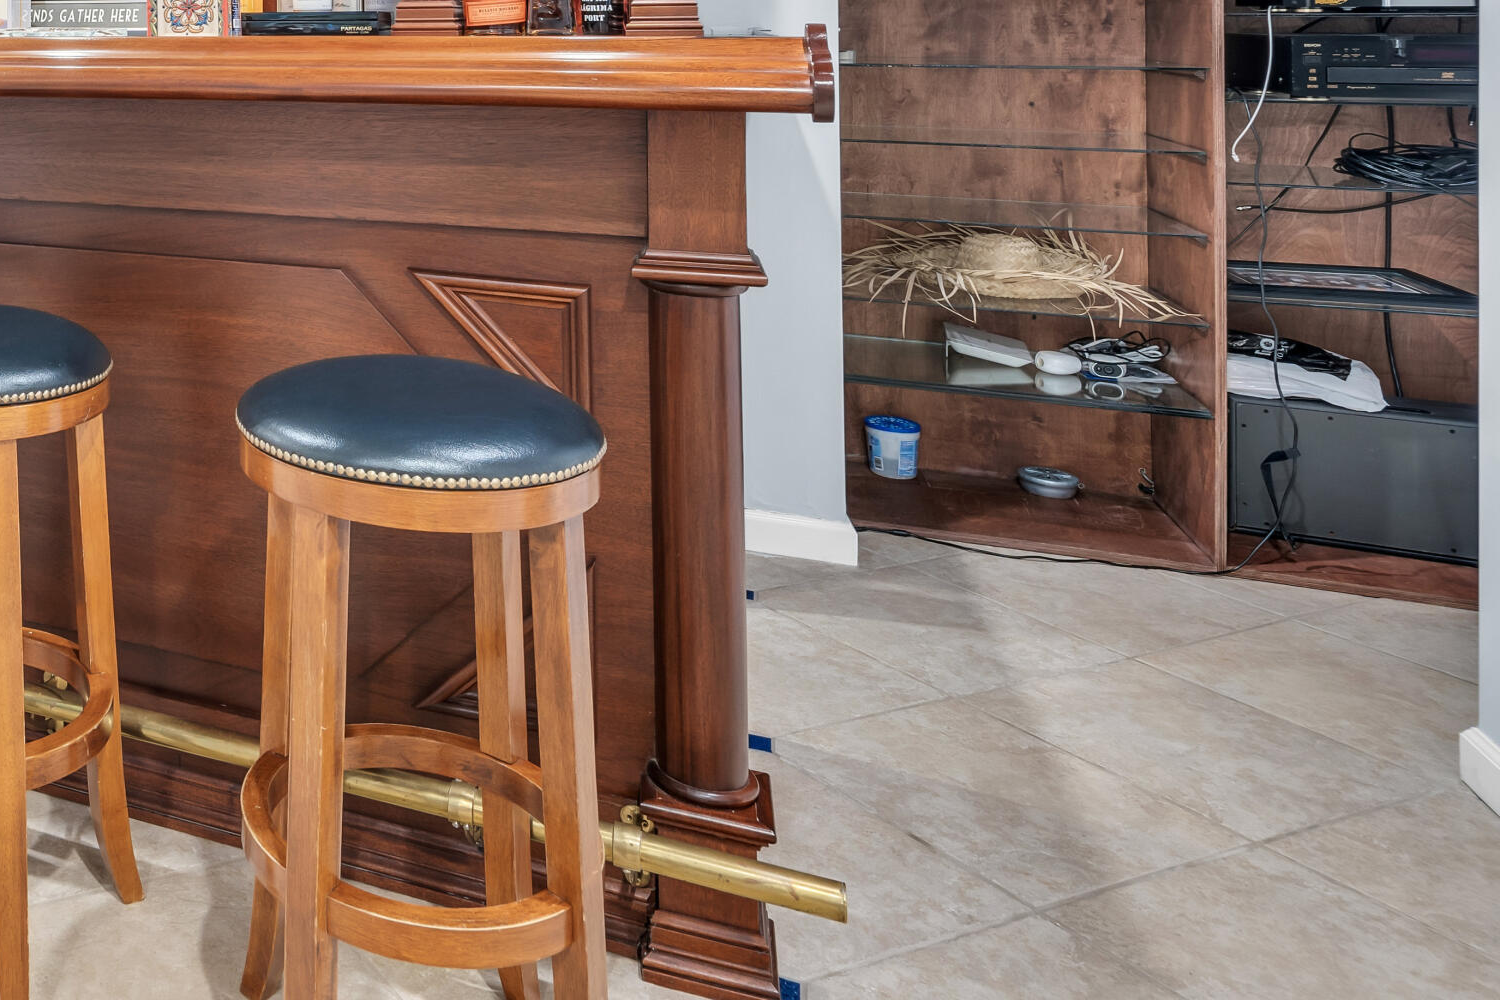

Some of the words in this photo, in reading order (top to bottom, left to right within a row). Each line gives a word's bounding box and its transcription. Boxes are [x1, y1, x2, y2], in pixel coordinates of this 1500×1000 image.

[59, 8, 105, 23] GATHER
[110, 8, 140, 23] HERE
[584, 14, 605, 22] PORT
